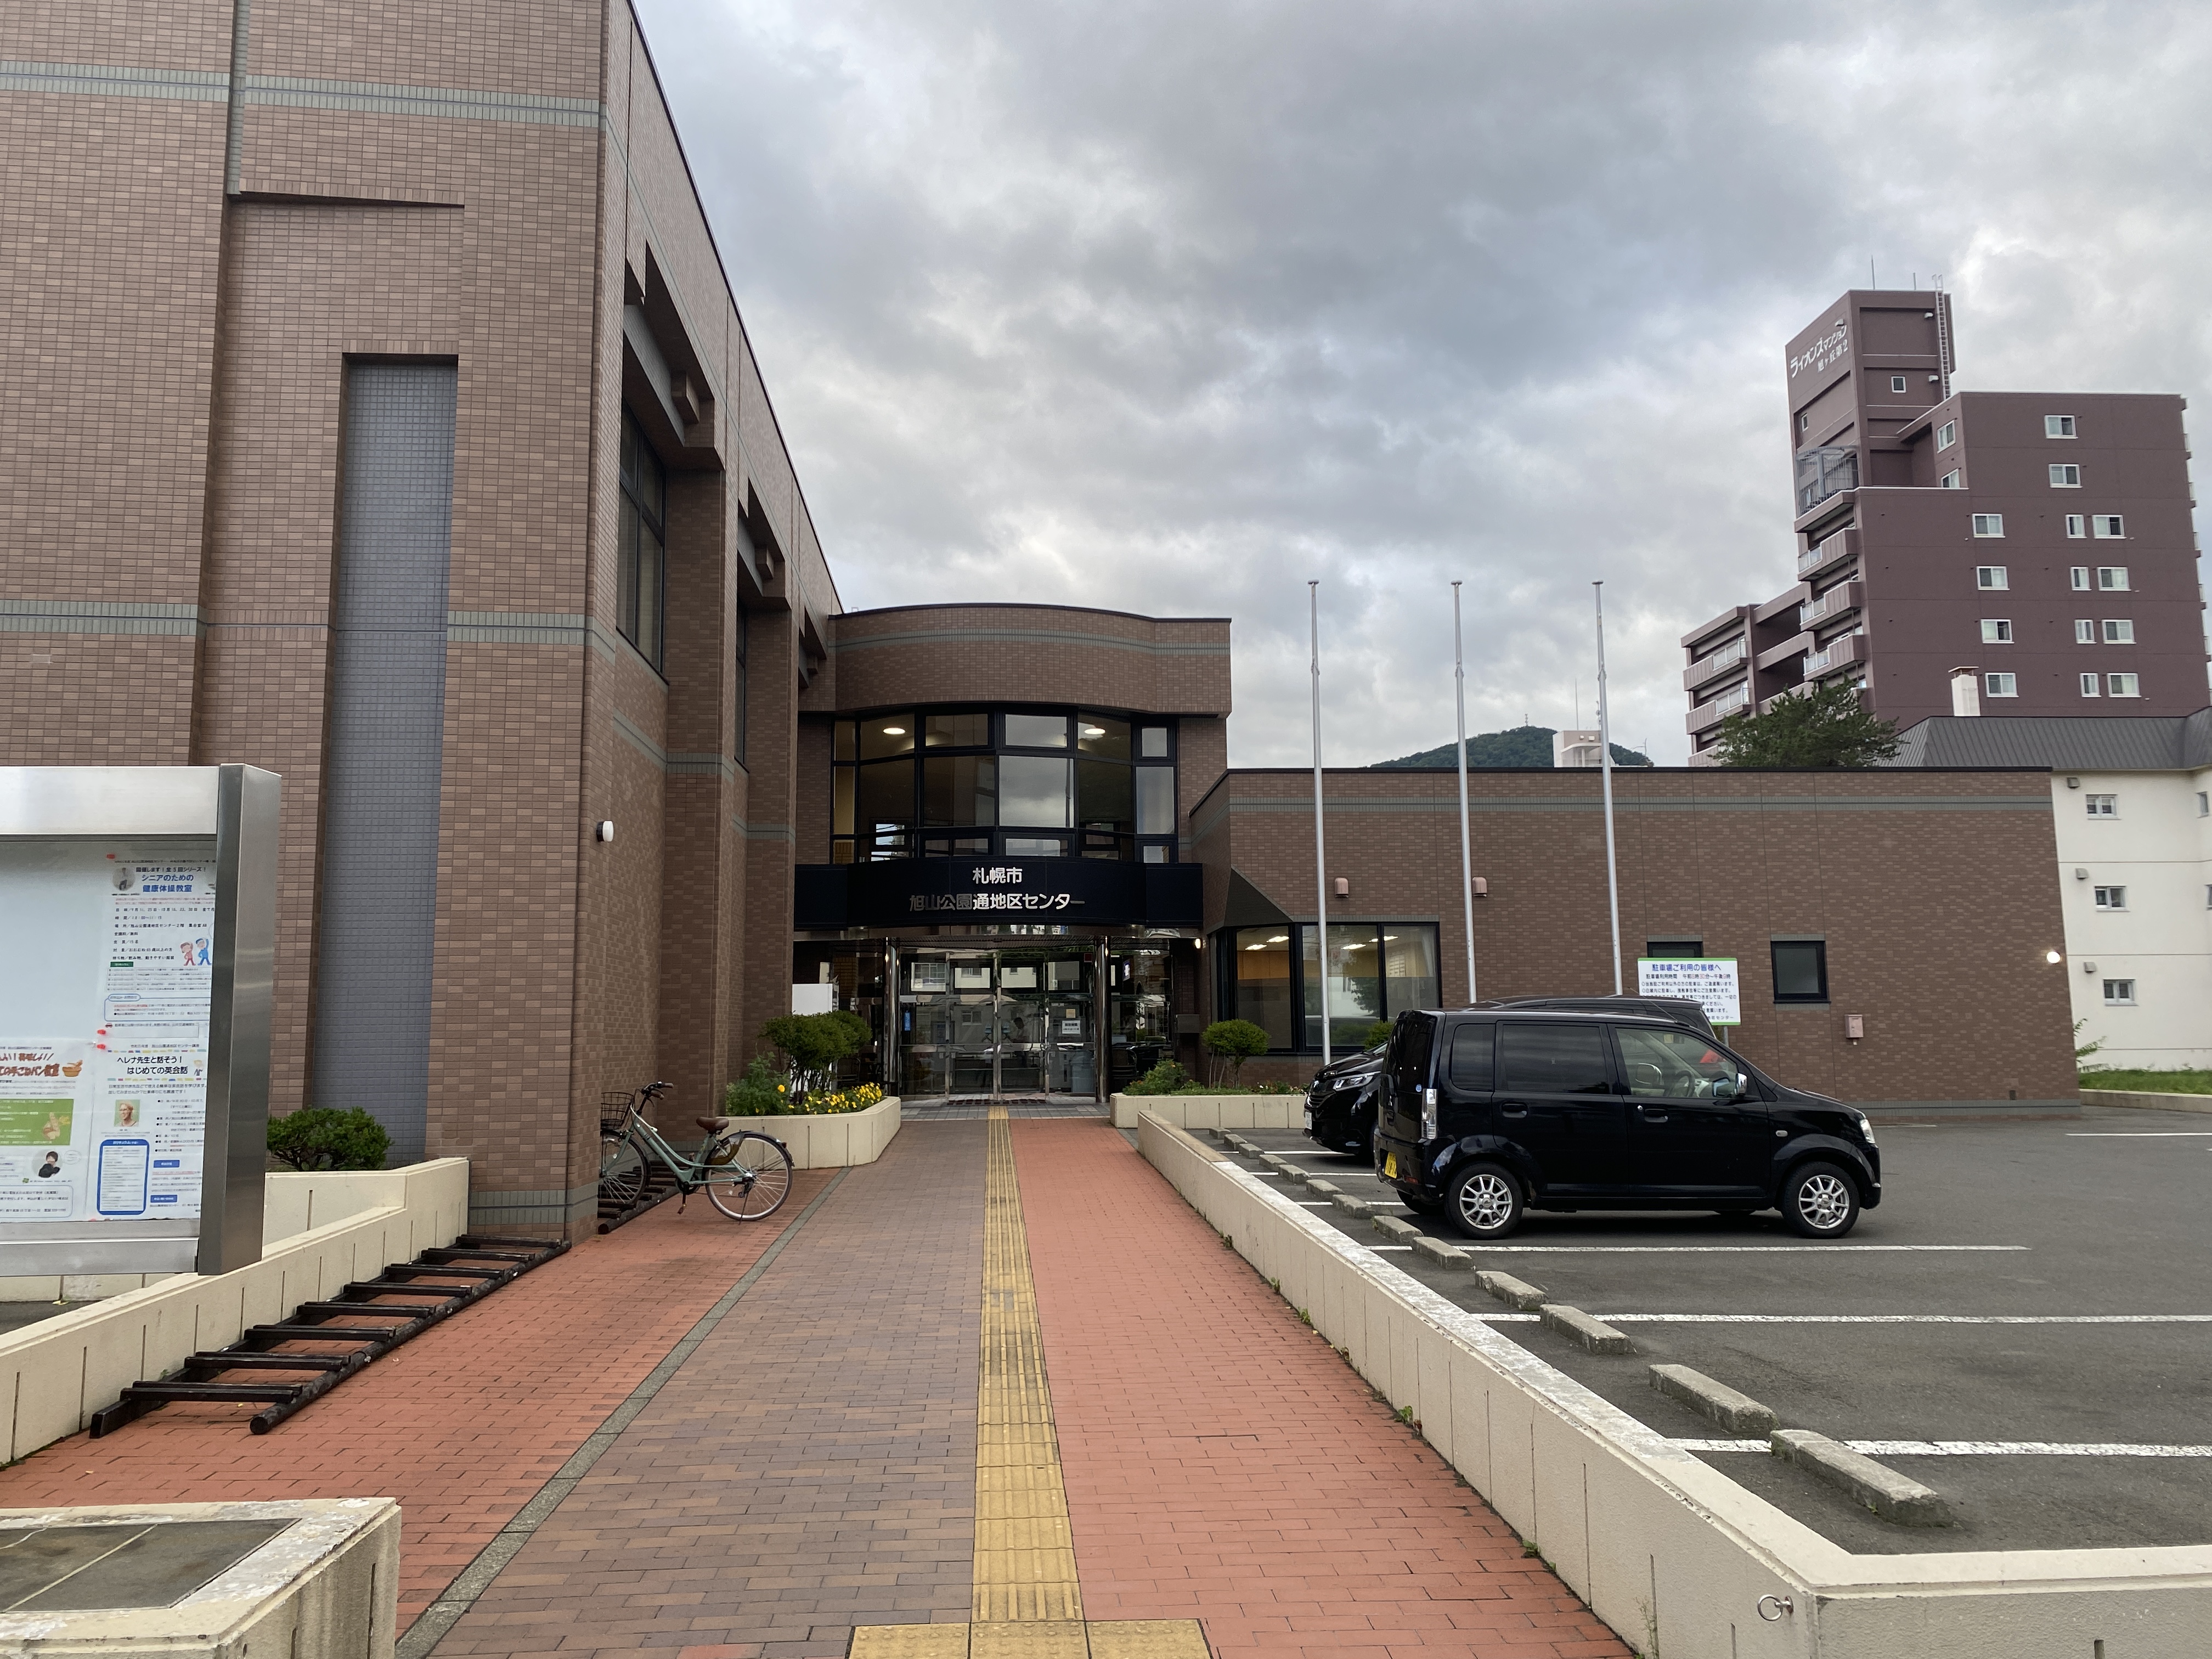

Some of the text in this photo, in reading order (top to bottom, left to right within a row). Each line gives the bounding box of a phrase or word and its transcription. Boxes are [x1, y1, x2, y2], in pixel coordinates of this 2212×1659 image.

[1790, 325, 1847, 379] ライオンズマンション
[972, 866, 1023, 884] 札幌市
[909, 893, 1085, 912] 旭山公園通地区センター
[117, 1056, 182, 1064] ヘレナ先生と話そう！
[127, 1066, 188, 1075] はじめての英会話
